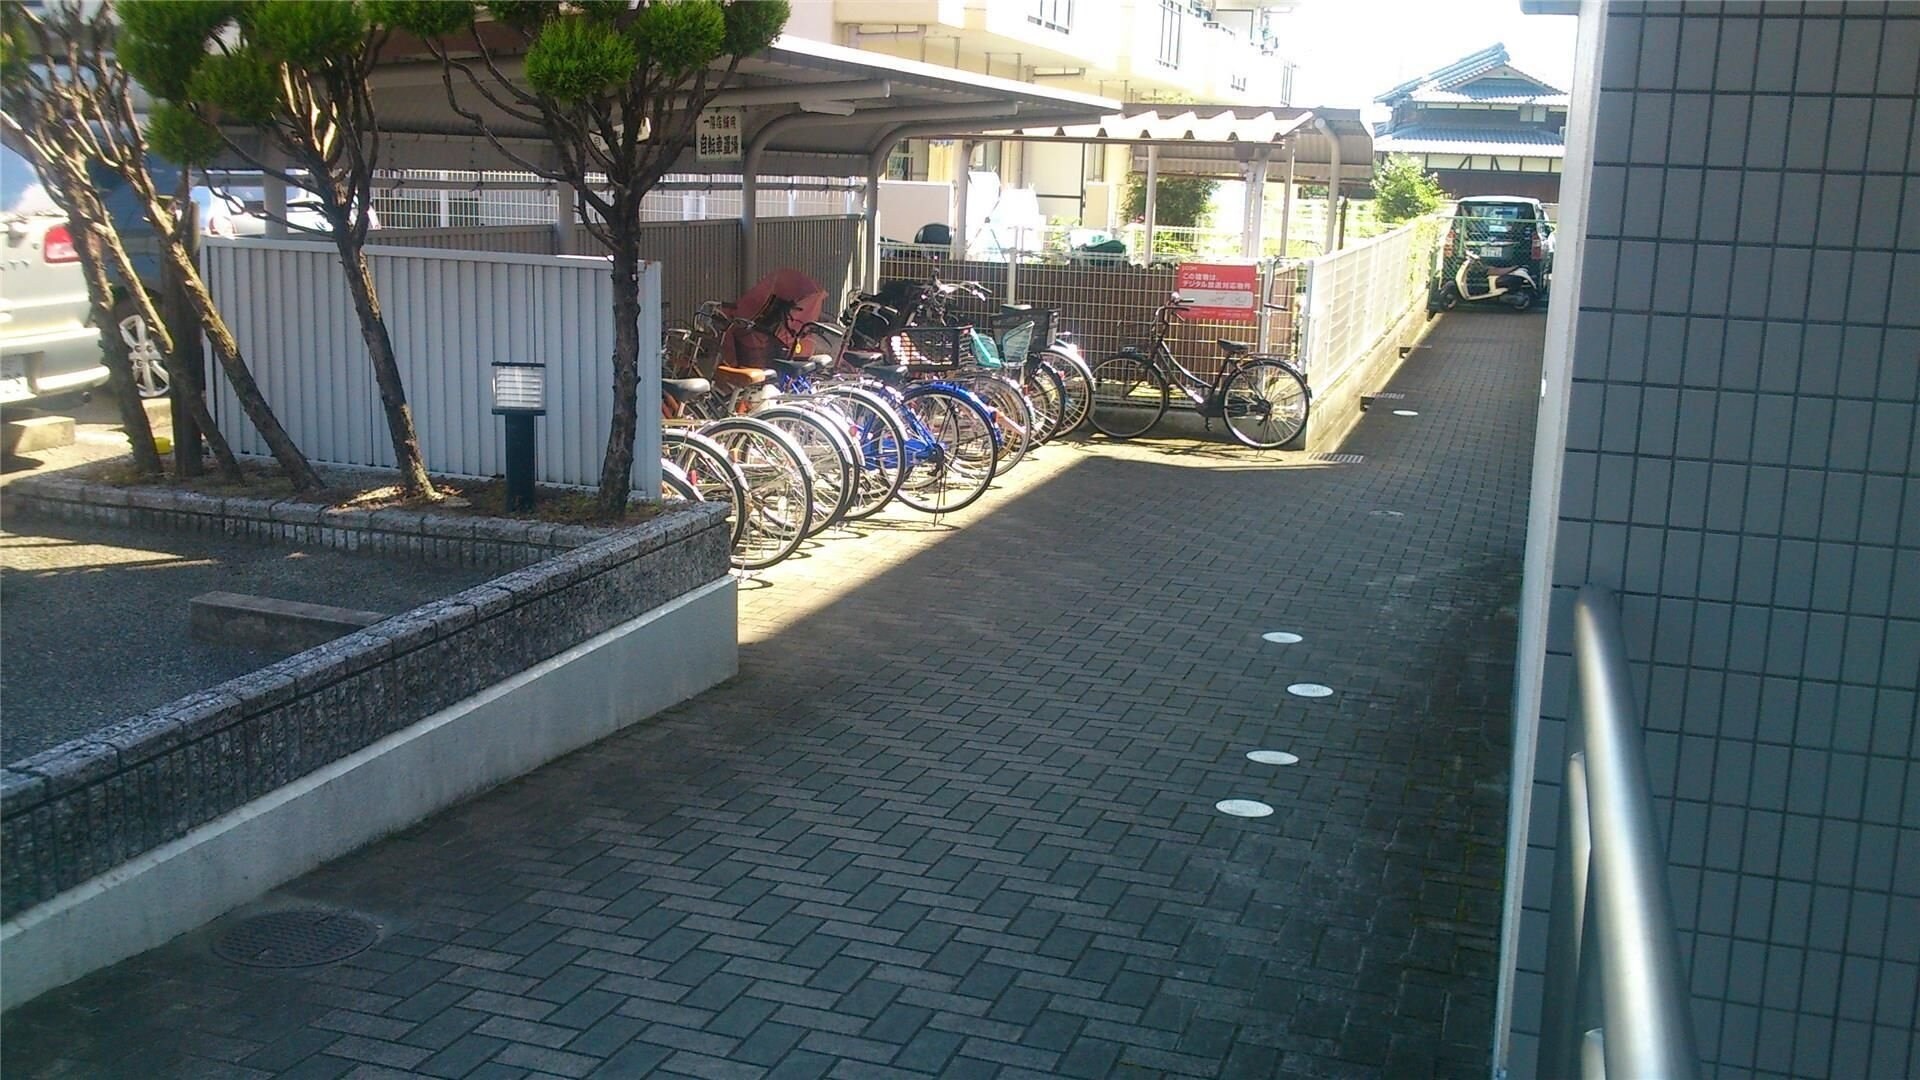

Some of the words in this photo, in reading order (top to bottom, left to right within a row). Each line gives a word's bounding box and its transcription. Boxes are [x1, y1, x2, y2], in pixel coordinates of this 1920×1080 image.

[700, 133, 739, 155] 自転車置場
